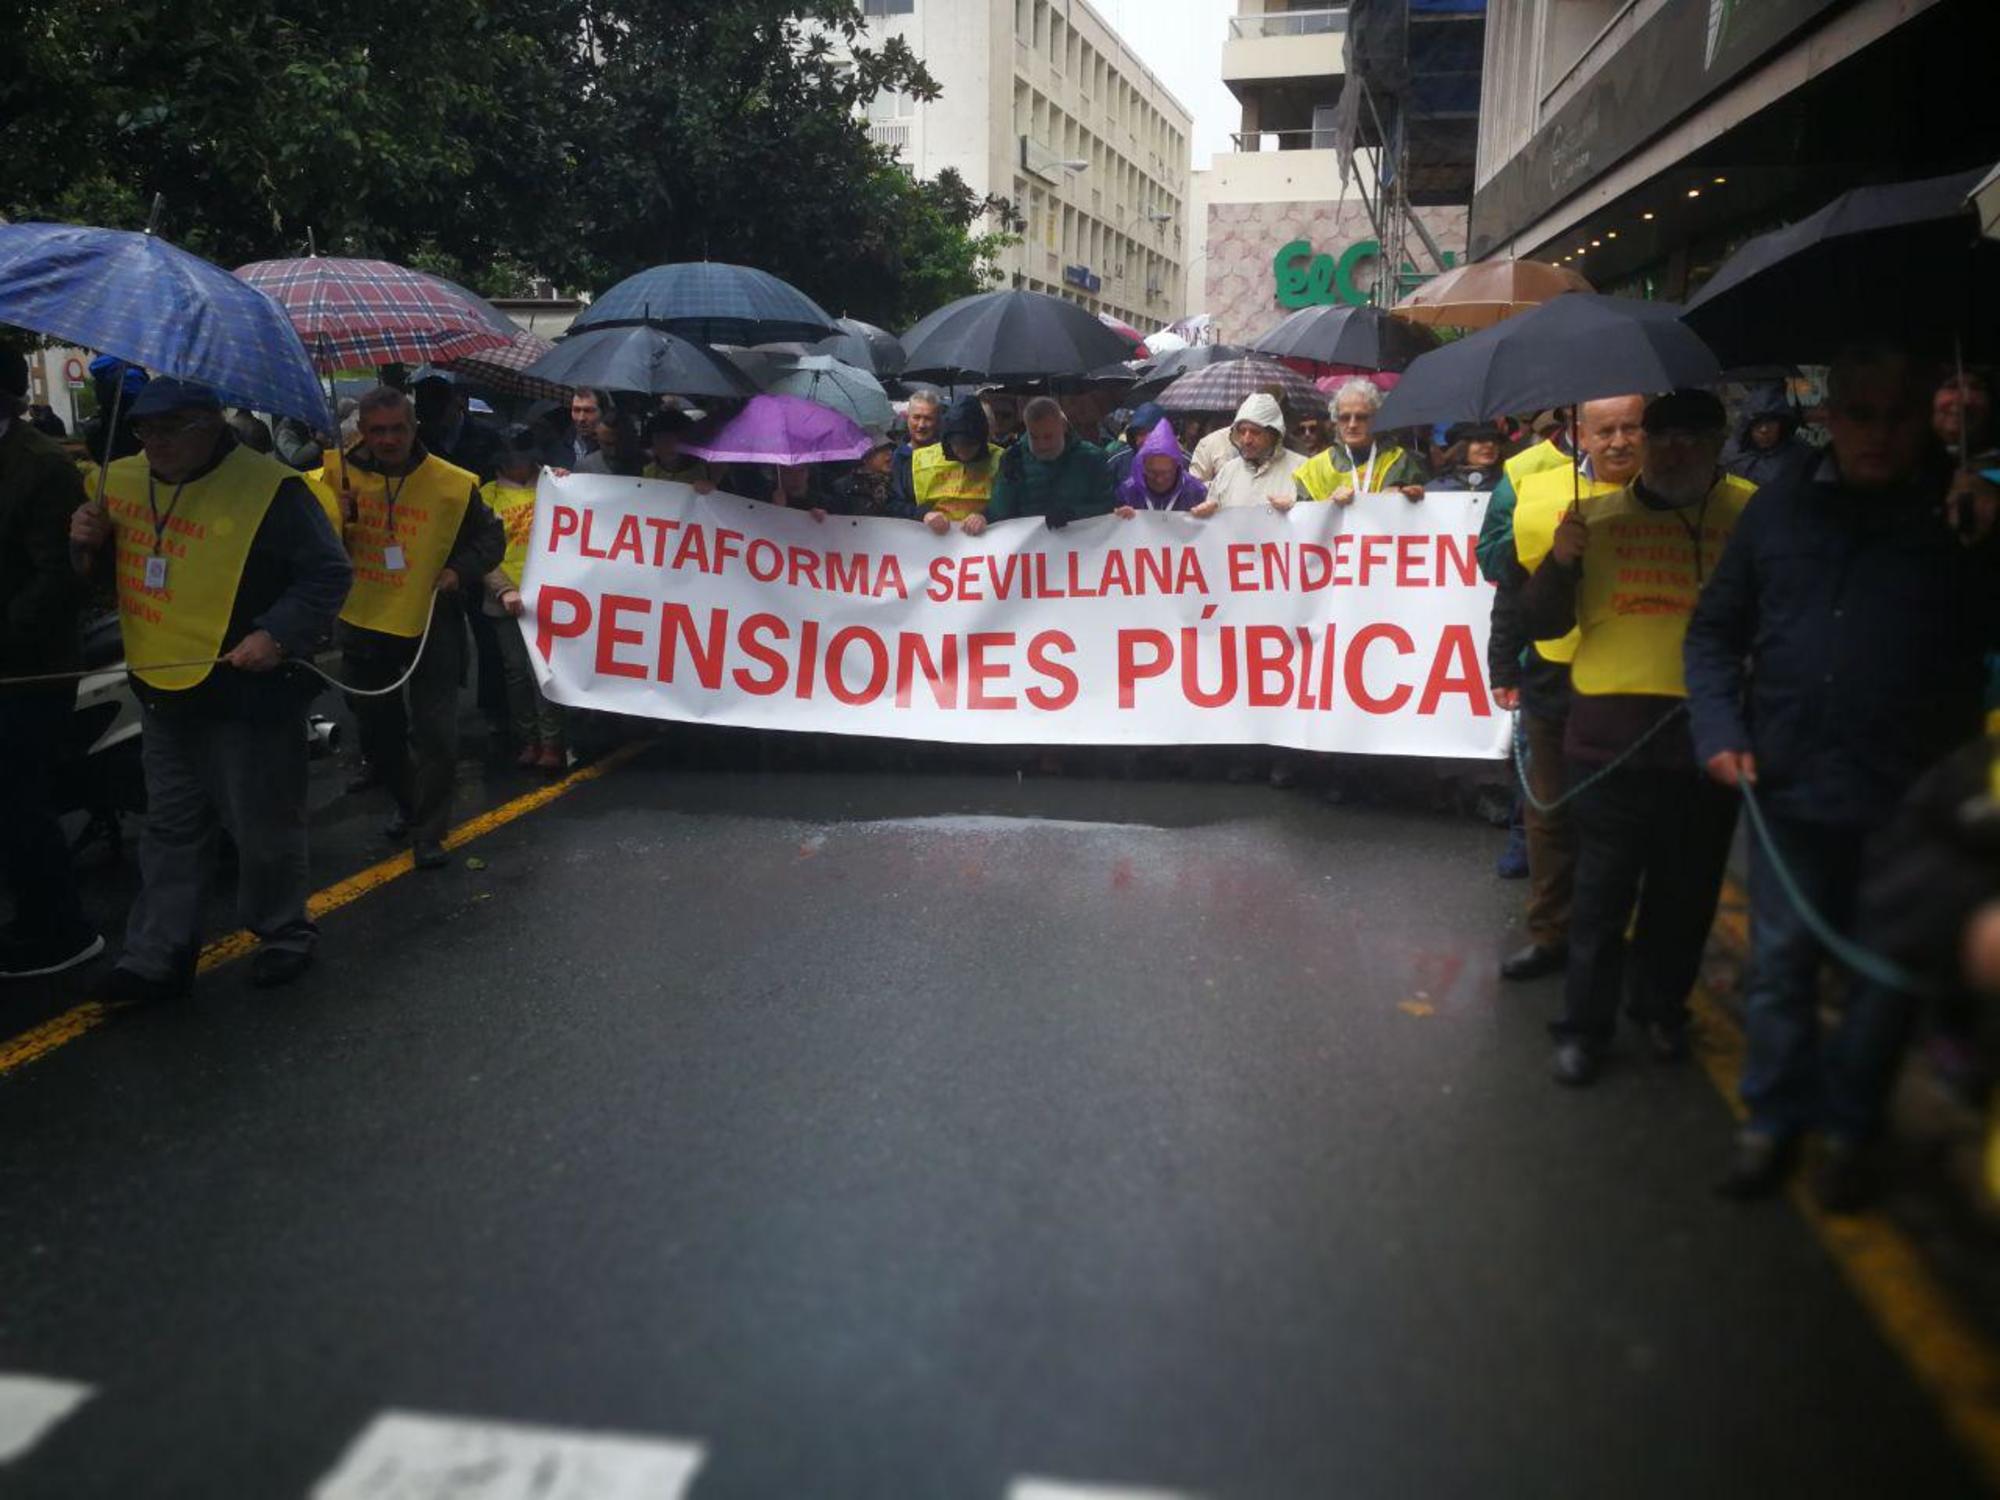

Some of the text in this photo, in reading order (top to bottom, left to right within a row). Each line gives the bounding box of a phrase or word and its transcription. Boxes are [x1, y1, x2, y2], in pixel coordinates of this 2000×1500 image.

[547, 505, 908, 600] PLATAFORMA
[926, 546, 1209, 603] SEVILLANA
[1298, 533, 1499, 594] DEFEN
[535, 583, 1080, 712] PENSIONES
